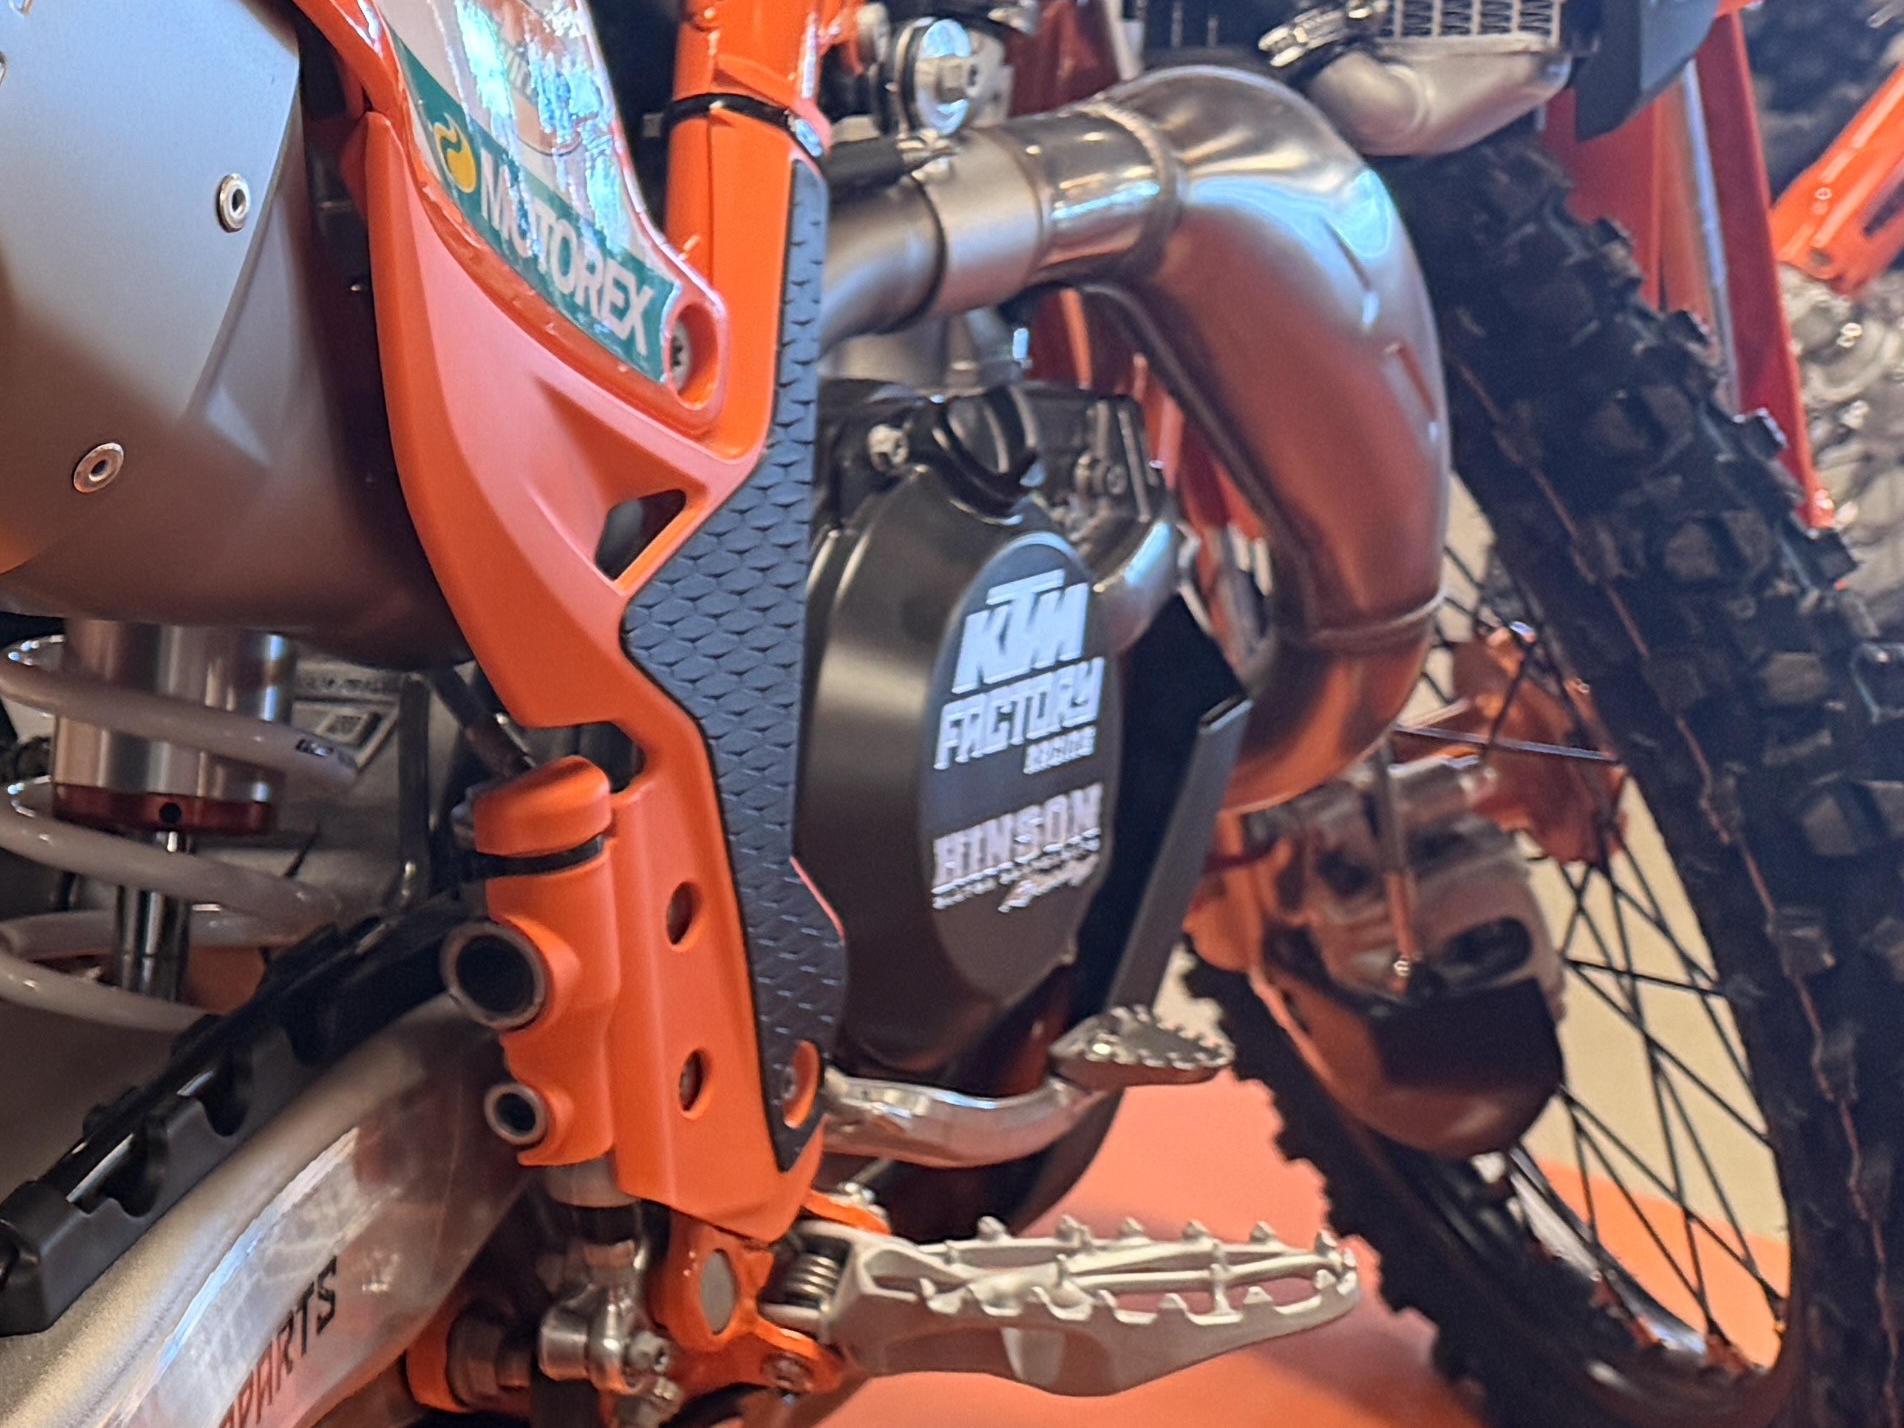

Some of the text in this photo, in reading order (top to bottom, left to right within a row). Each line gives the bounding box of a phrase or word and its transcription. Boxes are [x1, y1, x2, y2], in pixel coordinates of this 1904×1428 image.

[480, 147, 654, 356] MOTOREX
[951, 569, 1089, 694] KTM
[933, 656, 1105, 770] FACTORY
[932, 781, 1104, 894] HINSON
